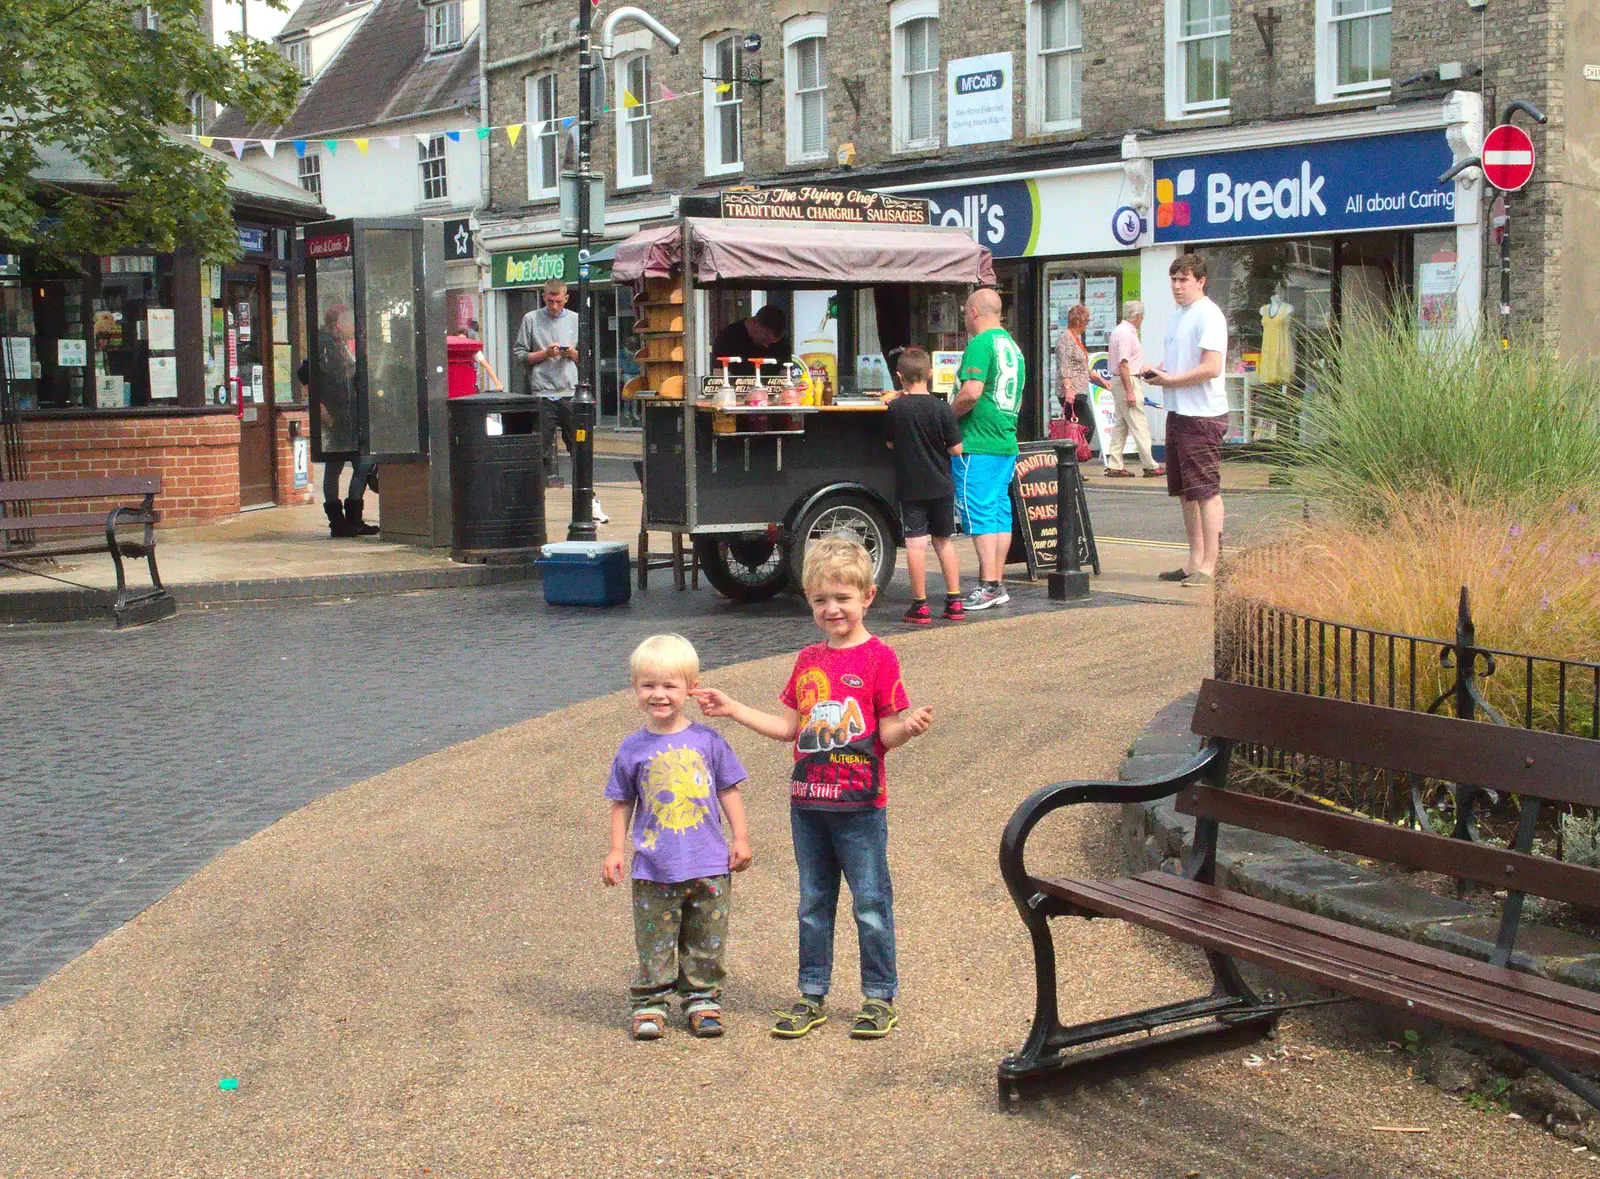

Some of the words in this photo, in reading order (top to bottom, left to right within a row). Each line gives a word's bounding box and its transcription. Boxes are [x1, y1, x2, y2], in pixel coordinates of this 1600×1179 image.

[962, 74, 997, 91] McColl's
[981, 104, 1004, 113] Extended
[771, 188, 796, 203] The
[799, 186, 844, 206] Flying
[847, 190, 879, 209] Chef
[1207, 160, 1327, 224] Break
[1346, 195, 1363, 214] All
[1366, 191, 1406, 212] about
[1409, 190, 1456, 210] Caring
[726, 203, 804, 219] TRADITIONAL
[807, 206, 863, 221] CHARGRILL
[867, 209, 924, 223] SAUSAGES
[931, 193, 1005, 244] oll's
[506, 253, 564, 283] beactive
[994, 332, 1023, 413] 8
